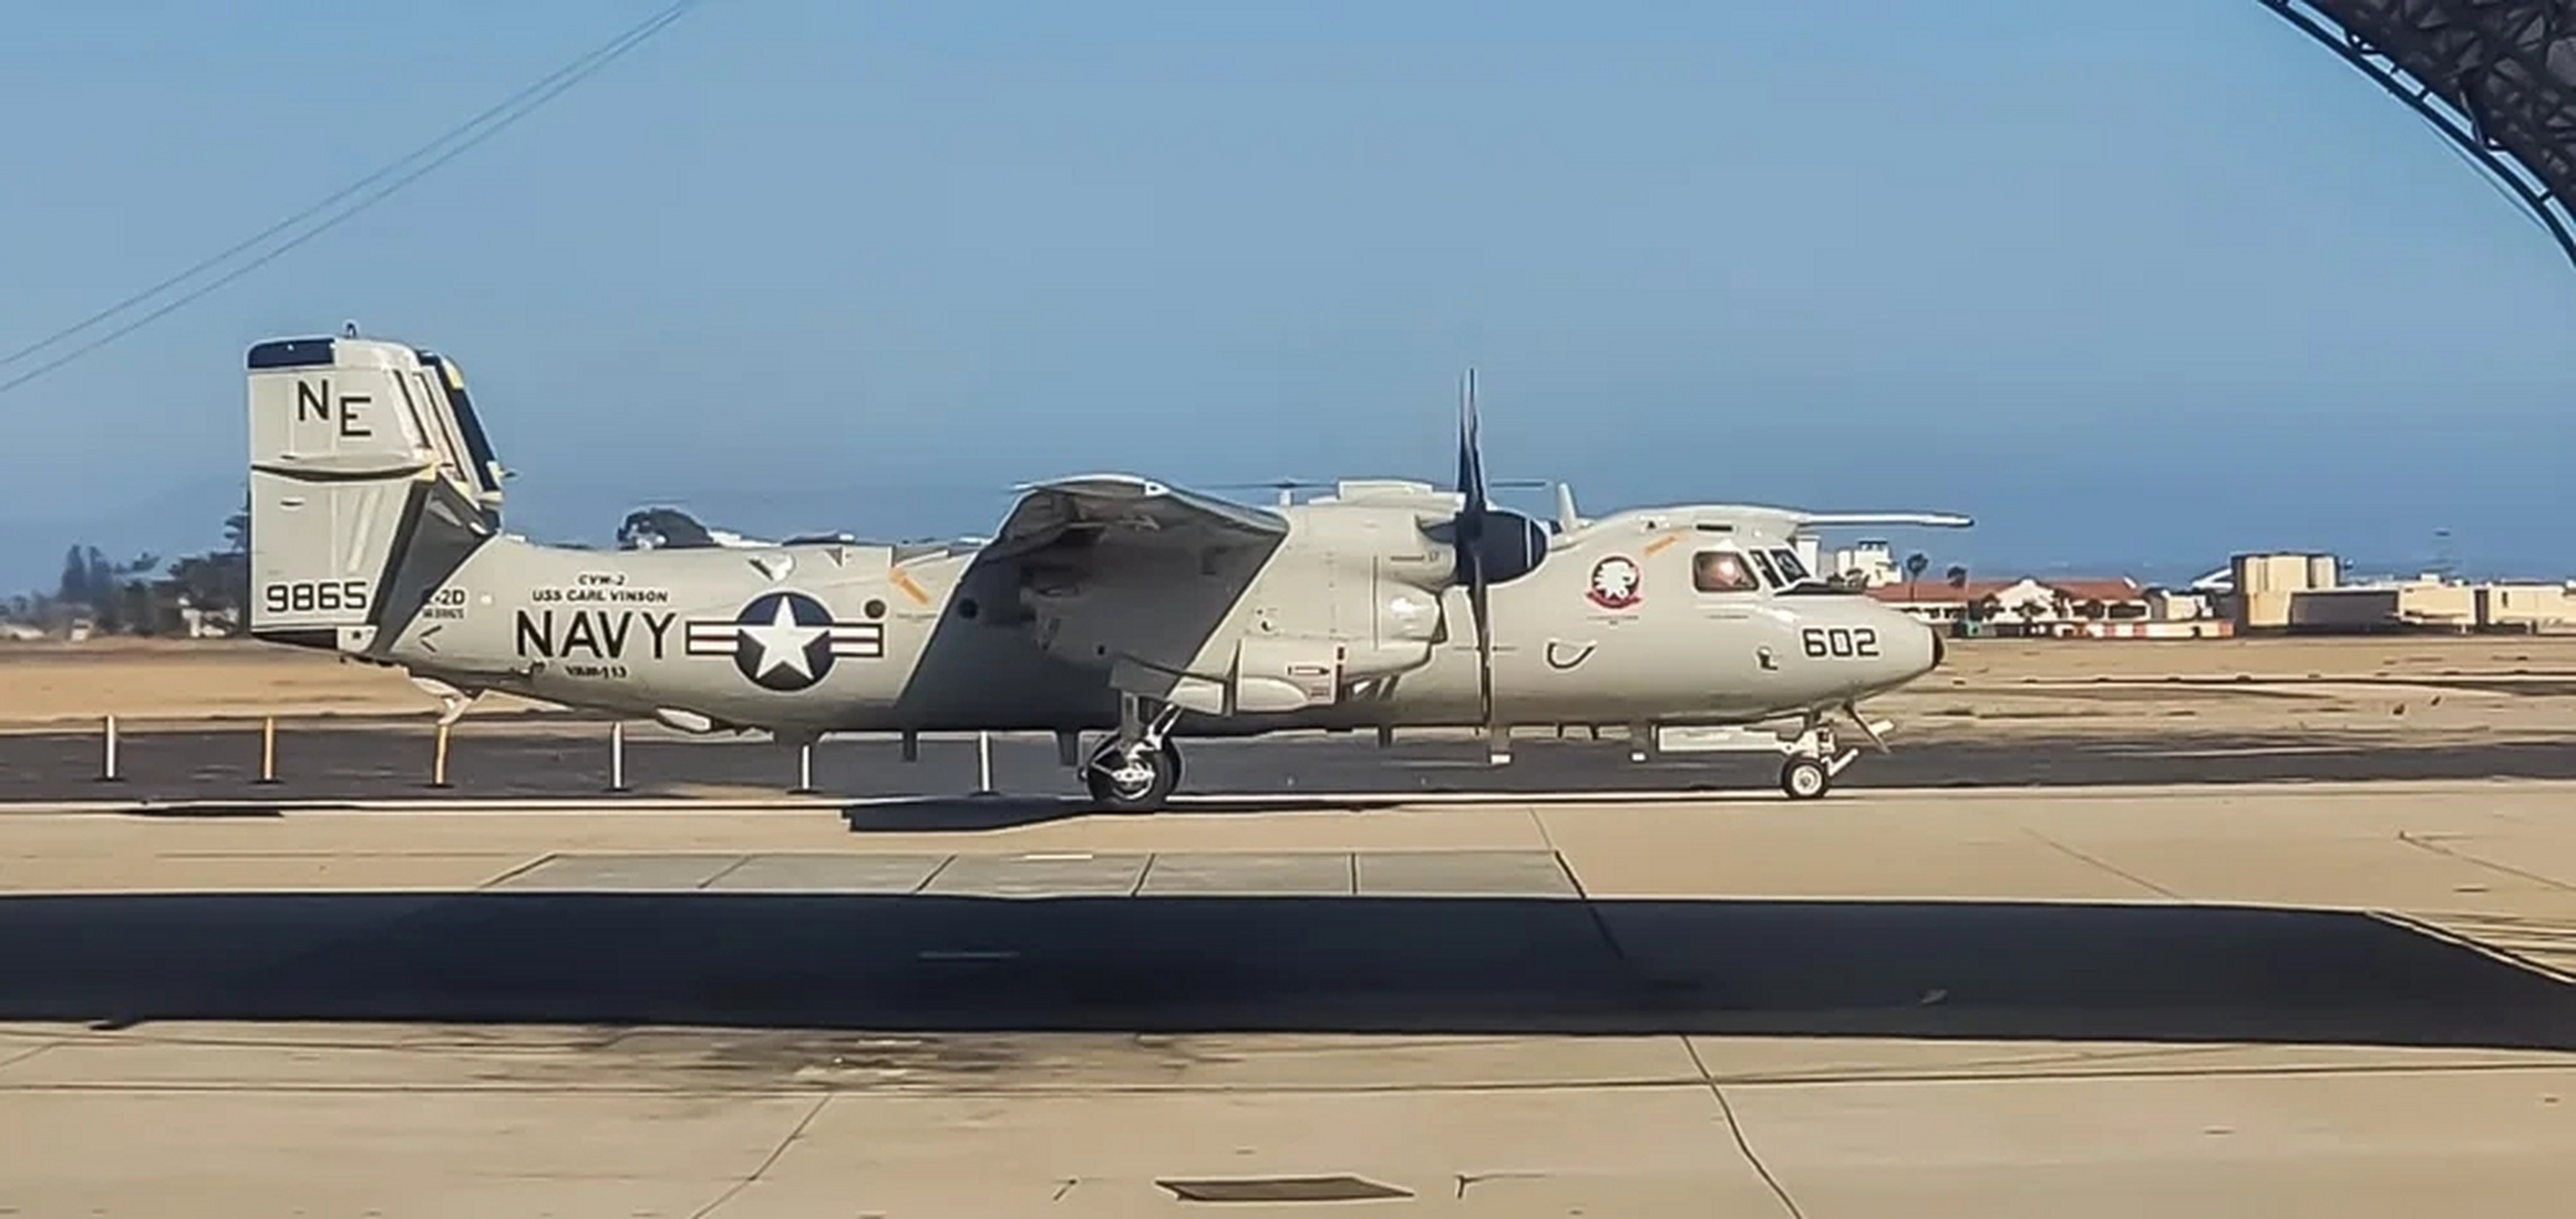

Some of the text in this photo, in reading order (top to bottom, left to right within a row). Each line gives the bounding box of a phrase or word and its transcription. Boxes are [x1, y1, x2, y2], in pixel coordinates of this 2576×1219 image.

[578, 573, 625, 587] CVW-2
[266, 581, 368, 613] 9865
[532, 589, 669, 603] USS CARL VINSON
[516, 610, 677, 660] NAVY
[1801, 627, 1880, 658] 602
